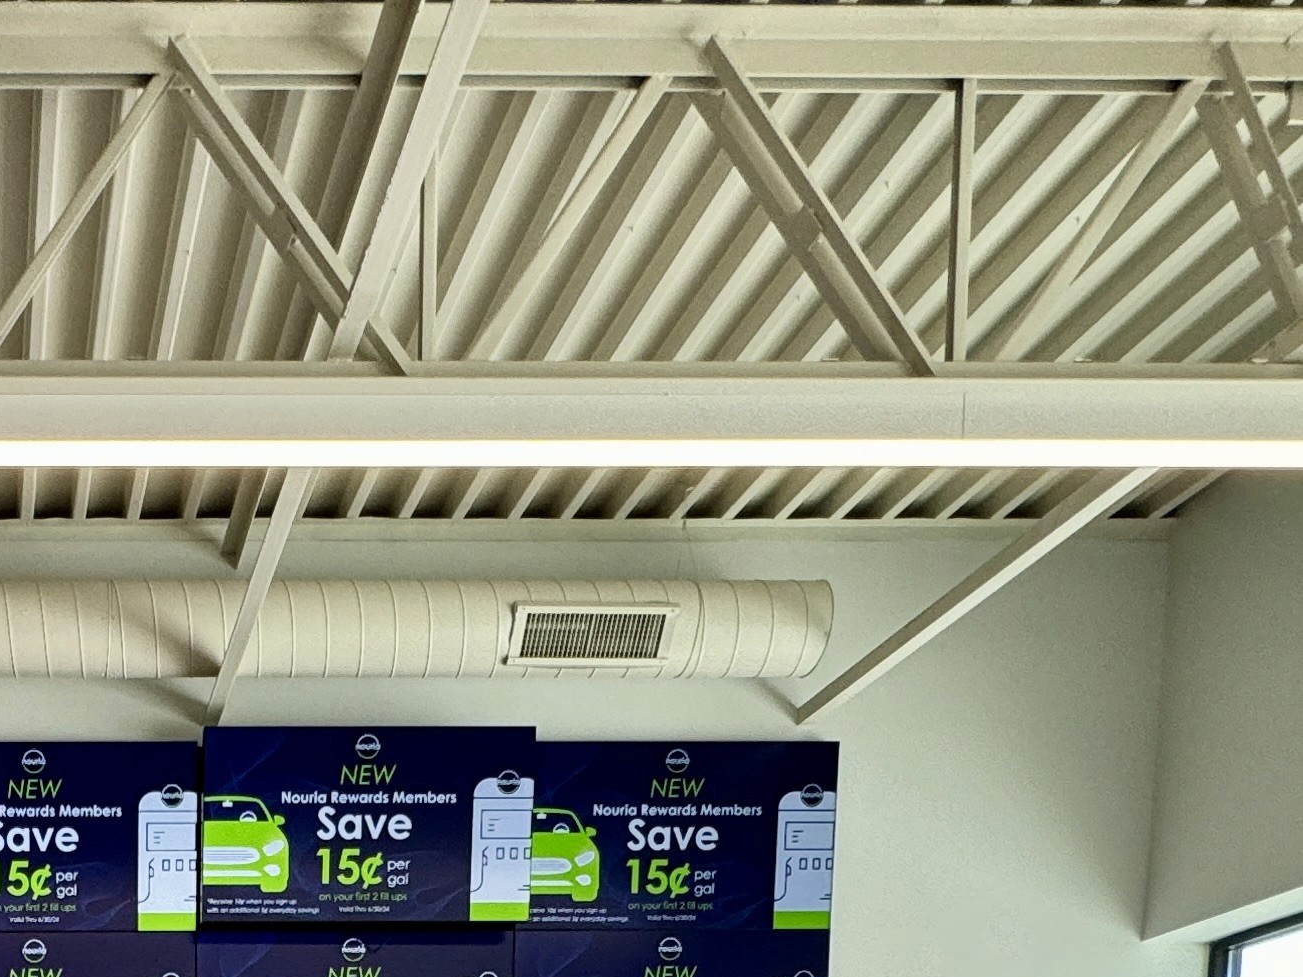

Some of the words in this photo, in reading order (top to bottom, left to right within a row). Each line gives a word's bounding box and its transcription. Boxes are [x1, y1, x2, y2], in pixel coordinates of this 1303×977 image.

[341, 764, 397, 785] NEW
[8, 779, 62, 799] NEW
[651, 778, 705, 798] NEW
[281, 791, 327, 804] Nouria
[331, 791, 389, 804] Rewards
[392, 791, 457, 804] Members
[0, 805, 56, 818] Rewards
[59, 805, 122, 818] Members
[593, 804, 637, 816] Nouria
[641, 804, 697, 817] Rewards
[700, 804, 762, 817] Members
[317, 806, 412, 840] Save
[627, 818, 719, 851] Save
[316, 848, 383, 888] 15¢
[387, 859, 410, 871] per
[56, 871, 78, 882] per
[388, 875, 409, 887] gal
[625, 859, 690, 898] 15¢
[694, 870, 717, 881] per
[57, 886, 77, 898] gal
[333, 894, 353, 902] your
[356, 892, 370, 900] first
[380, 892, 389, 900] fill
[391, 894, 408, 902] ups
[694, 884, 715, 897] gal
[4, 904, 23, 913] your
[26, 903, 40, 911] first
[42, 903, 48, 911] 2
[50, 903, 58, 911] fill
[60, 904, 77, 913] ups
[642, 903, 661, 911] your
[663, 901, 678, 909] first
[687, 901, 695, 909] fill
[698, 903, 714, 911] ups
